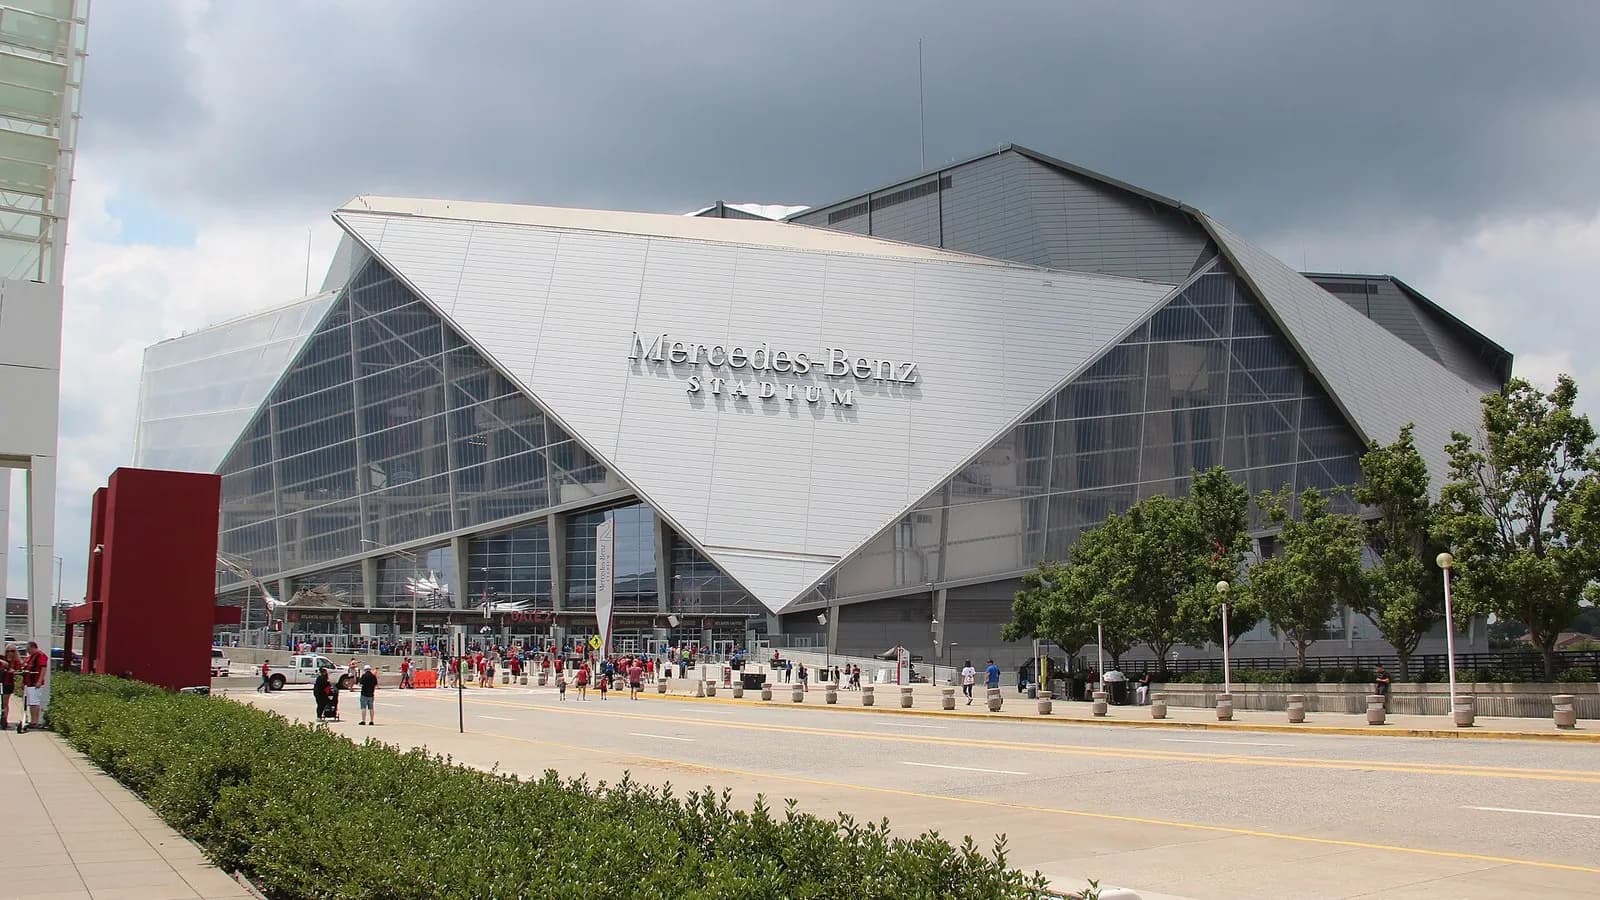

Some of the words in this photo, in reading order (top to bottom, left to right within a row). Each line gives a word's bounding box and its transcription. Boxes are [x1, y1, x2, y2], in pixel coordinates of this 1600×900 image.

[628, 331, 919, 384] Mercedes-Benz
[687, 375, 854, 407] STADIUM
[511, 610, 542, 623] GATE
